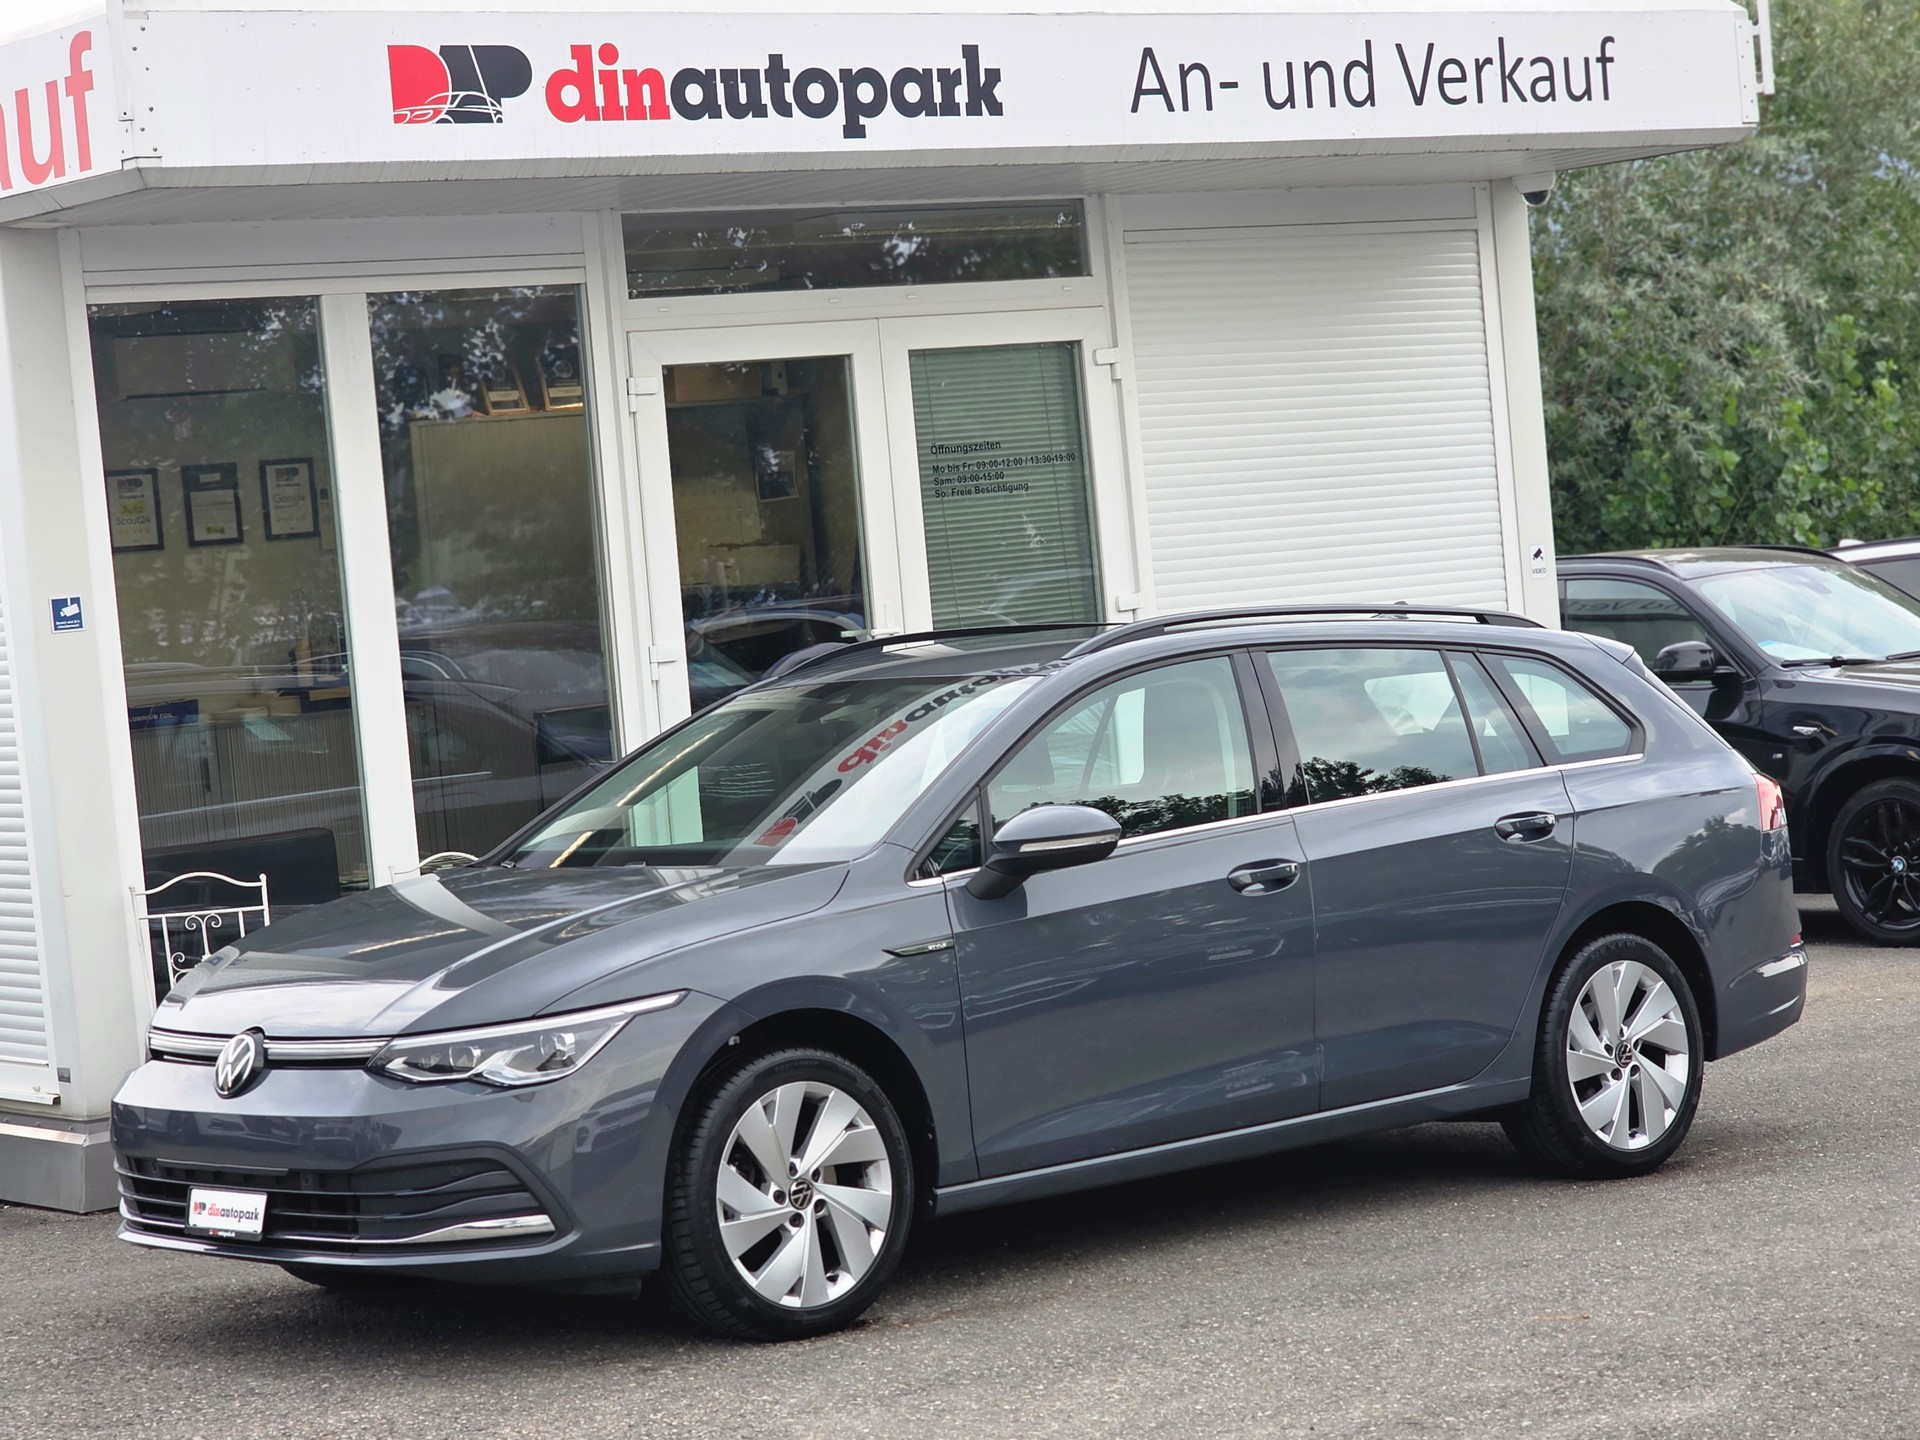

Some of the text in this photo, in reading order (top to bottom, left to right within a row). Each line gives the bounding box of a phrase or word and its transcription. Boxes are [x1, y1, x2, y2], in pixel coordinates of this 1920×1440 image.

[1130, 36, 1615, 113] An- und Verkauf
[545, 42, 1004, 139] dinautopark
[930, 440, 1002, 455] Öffnungszeiten
[932, 465, 945, 474] Mo
[947, 463, 960, 473] bis
[962, 462, 974, 471] Fr:
[976, 457, 1023, 470] 09:00-12:00
[1030, 452, 1076, 465] 13:30-19:00
[933, 471, 1005, 486] Sam: 09:00-15:00
[934, 482, 1029, 498] So: Freie Besichtigung
[207, 1202, 260, 1223] dinautopark
